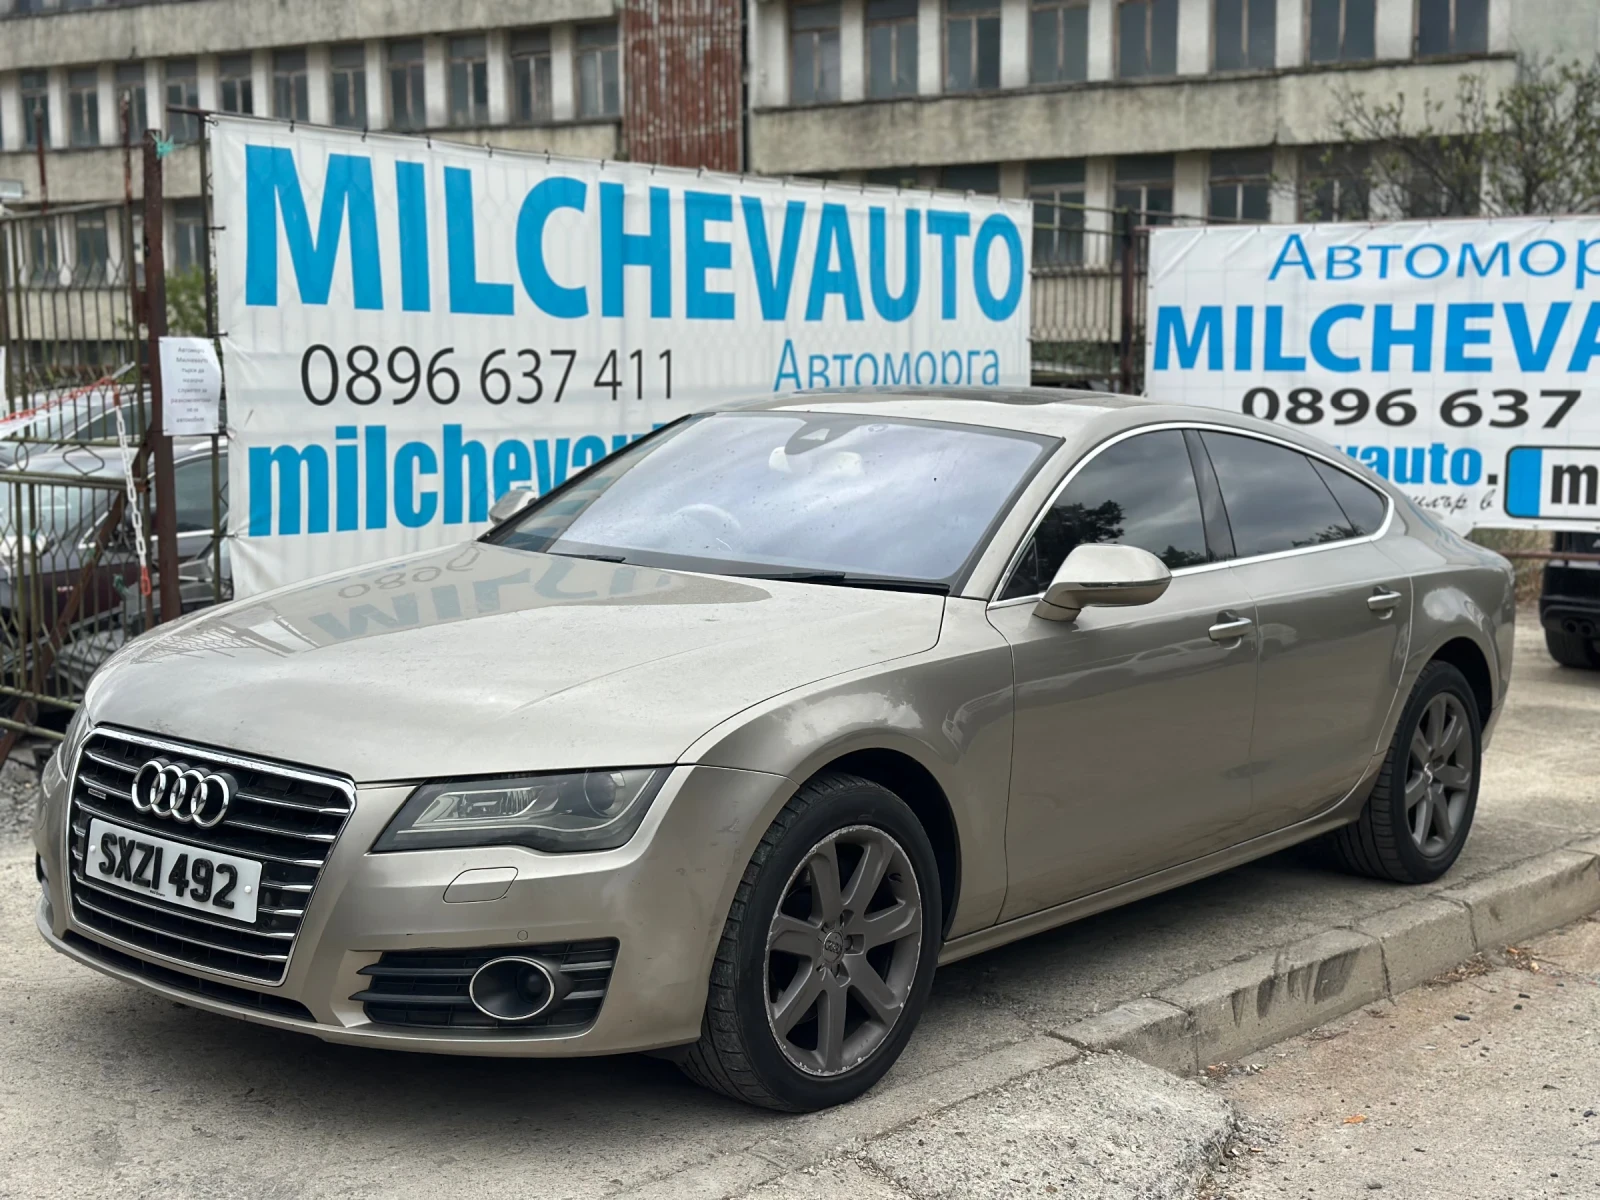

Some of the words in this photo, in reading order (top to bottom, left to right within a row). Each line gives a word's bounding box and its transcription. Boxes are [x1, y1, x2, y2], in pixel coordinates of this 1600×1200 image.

[245, 144, 1025, 322] MILCHEVAUTO
[301, 344, 460, 406] 0896
[480, 347, 577, 405] 637
[594, 349, 671, 401] 411
[773, 338, 999, 391] Автоморга
[1242, 386, 1418, 427] 0896
[1440, 388, 1583, 430] 637
[1334, 443, 1498, 487] auto.
[167, 853, 238, 909] 492
